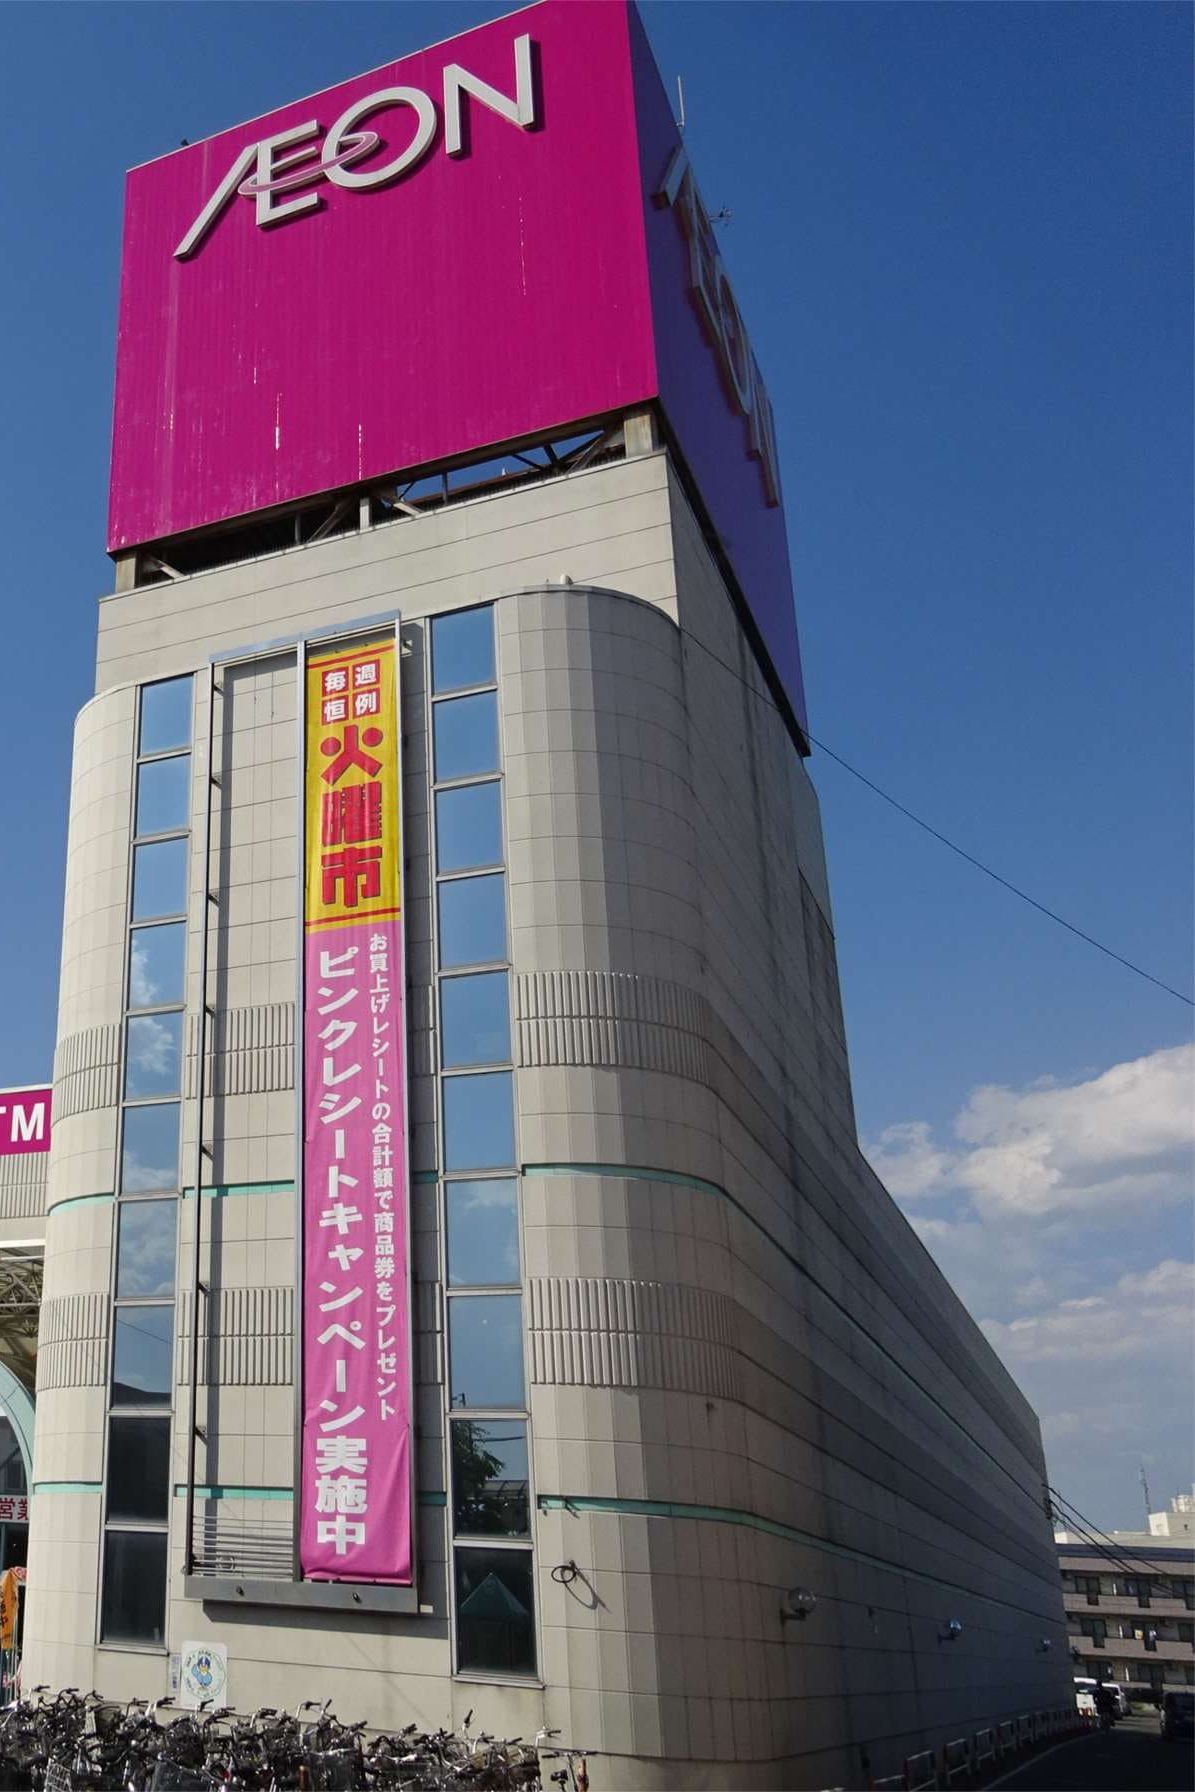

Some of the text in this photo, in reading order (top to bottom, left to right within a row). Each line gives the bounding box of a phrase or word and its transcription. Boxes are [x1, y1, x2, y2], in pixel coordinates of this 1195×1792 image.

[319, 724, 384, 908] 火曜市
[315, 946, 368, 1555] ピンクレシートキャンペーン実施中
[369, 933, 397, 1421] お買上げレシートの合計額で商品券をプレゼント
